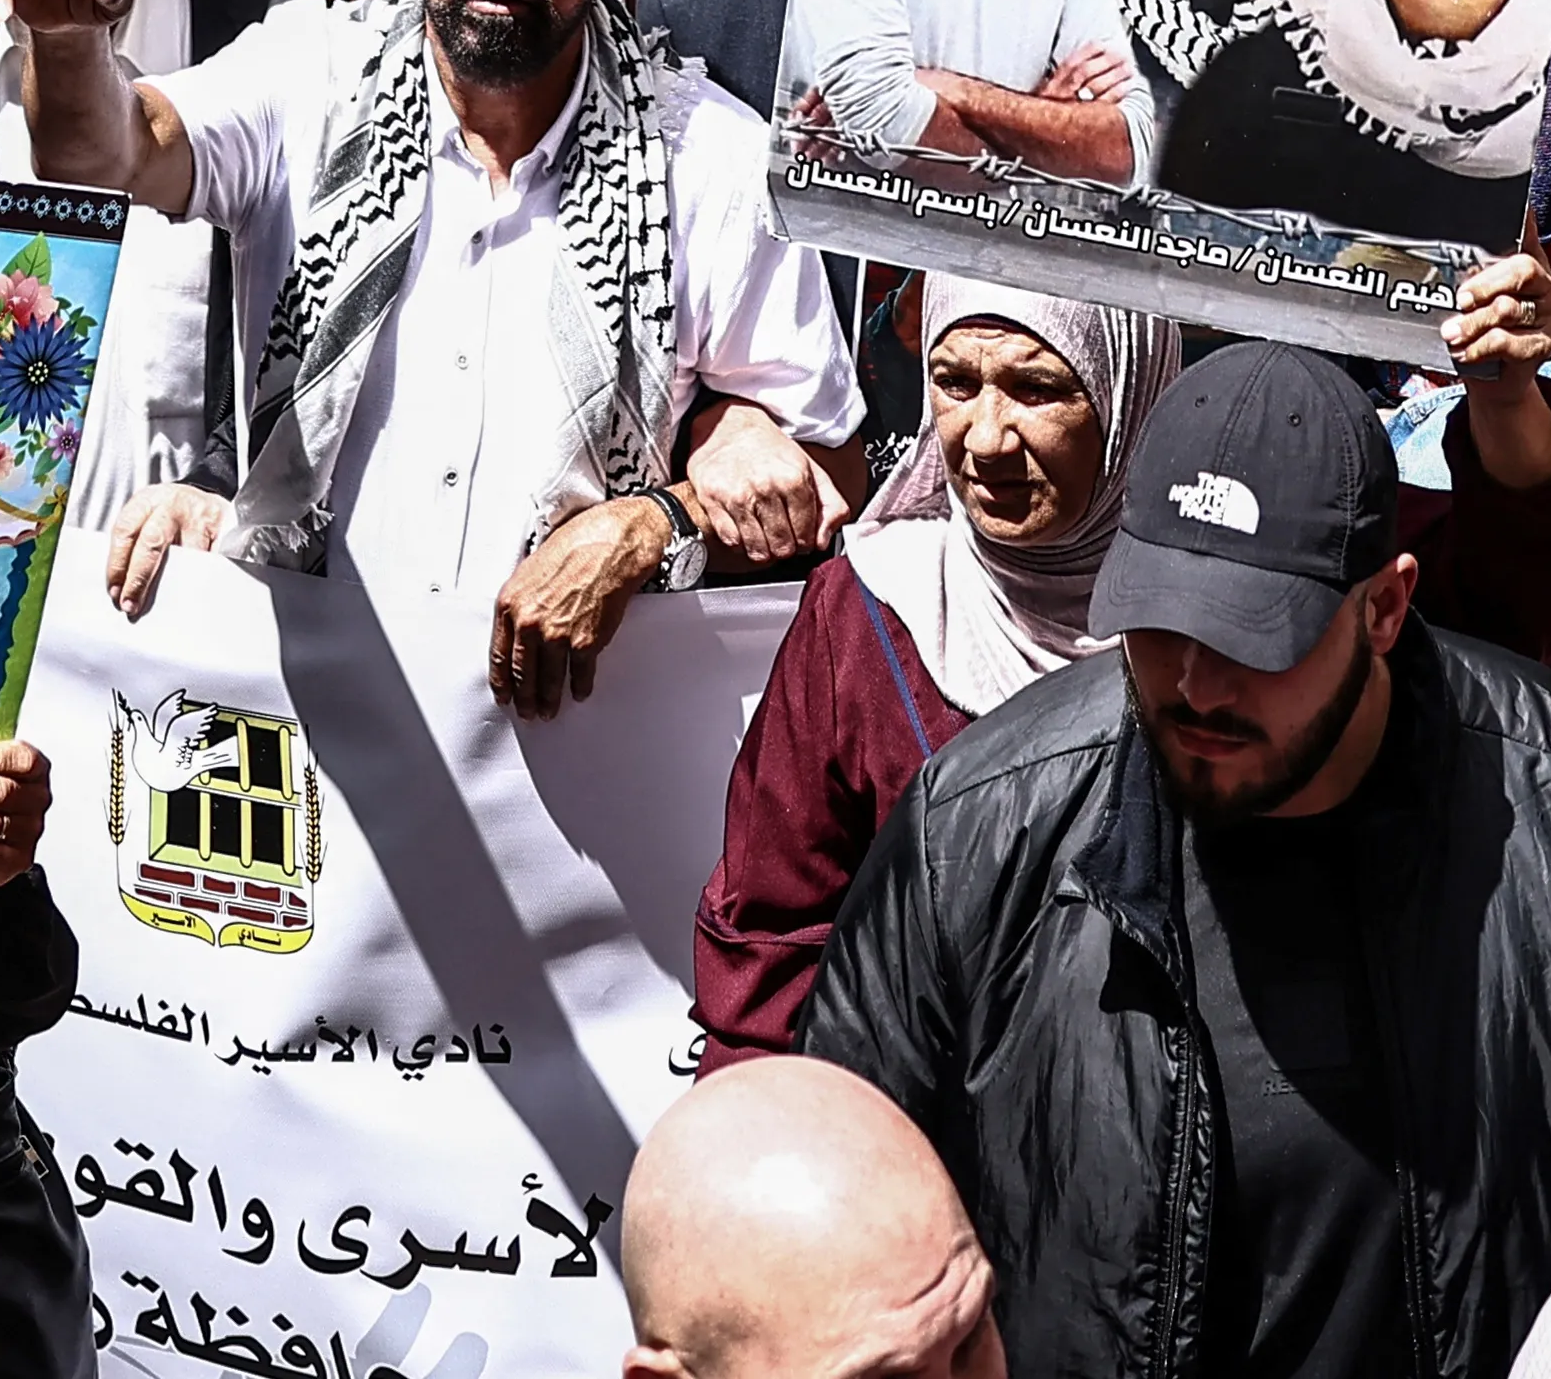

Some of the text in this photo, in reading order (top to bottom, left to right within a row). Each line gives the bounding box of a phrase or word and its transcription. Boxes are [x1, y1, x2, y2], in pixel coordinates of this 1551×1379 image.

[785, 157, 913, 207] النعسان
[914, 190, 999, 228] باسم
[1022, 202, 1155, 252] النعسان
[1153, 226, 1231, 270] ماجد
[1255, 248, 1388, 298] النعسان
[214, 1014, 379, 1078] الأسير
[391, 1022, 514, 1083] نادي
[46, 1131, 615, 1291] لأسرى والقو
